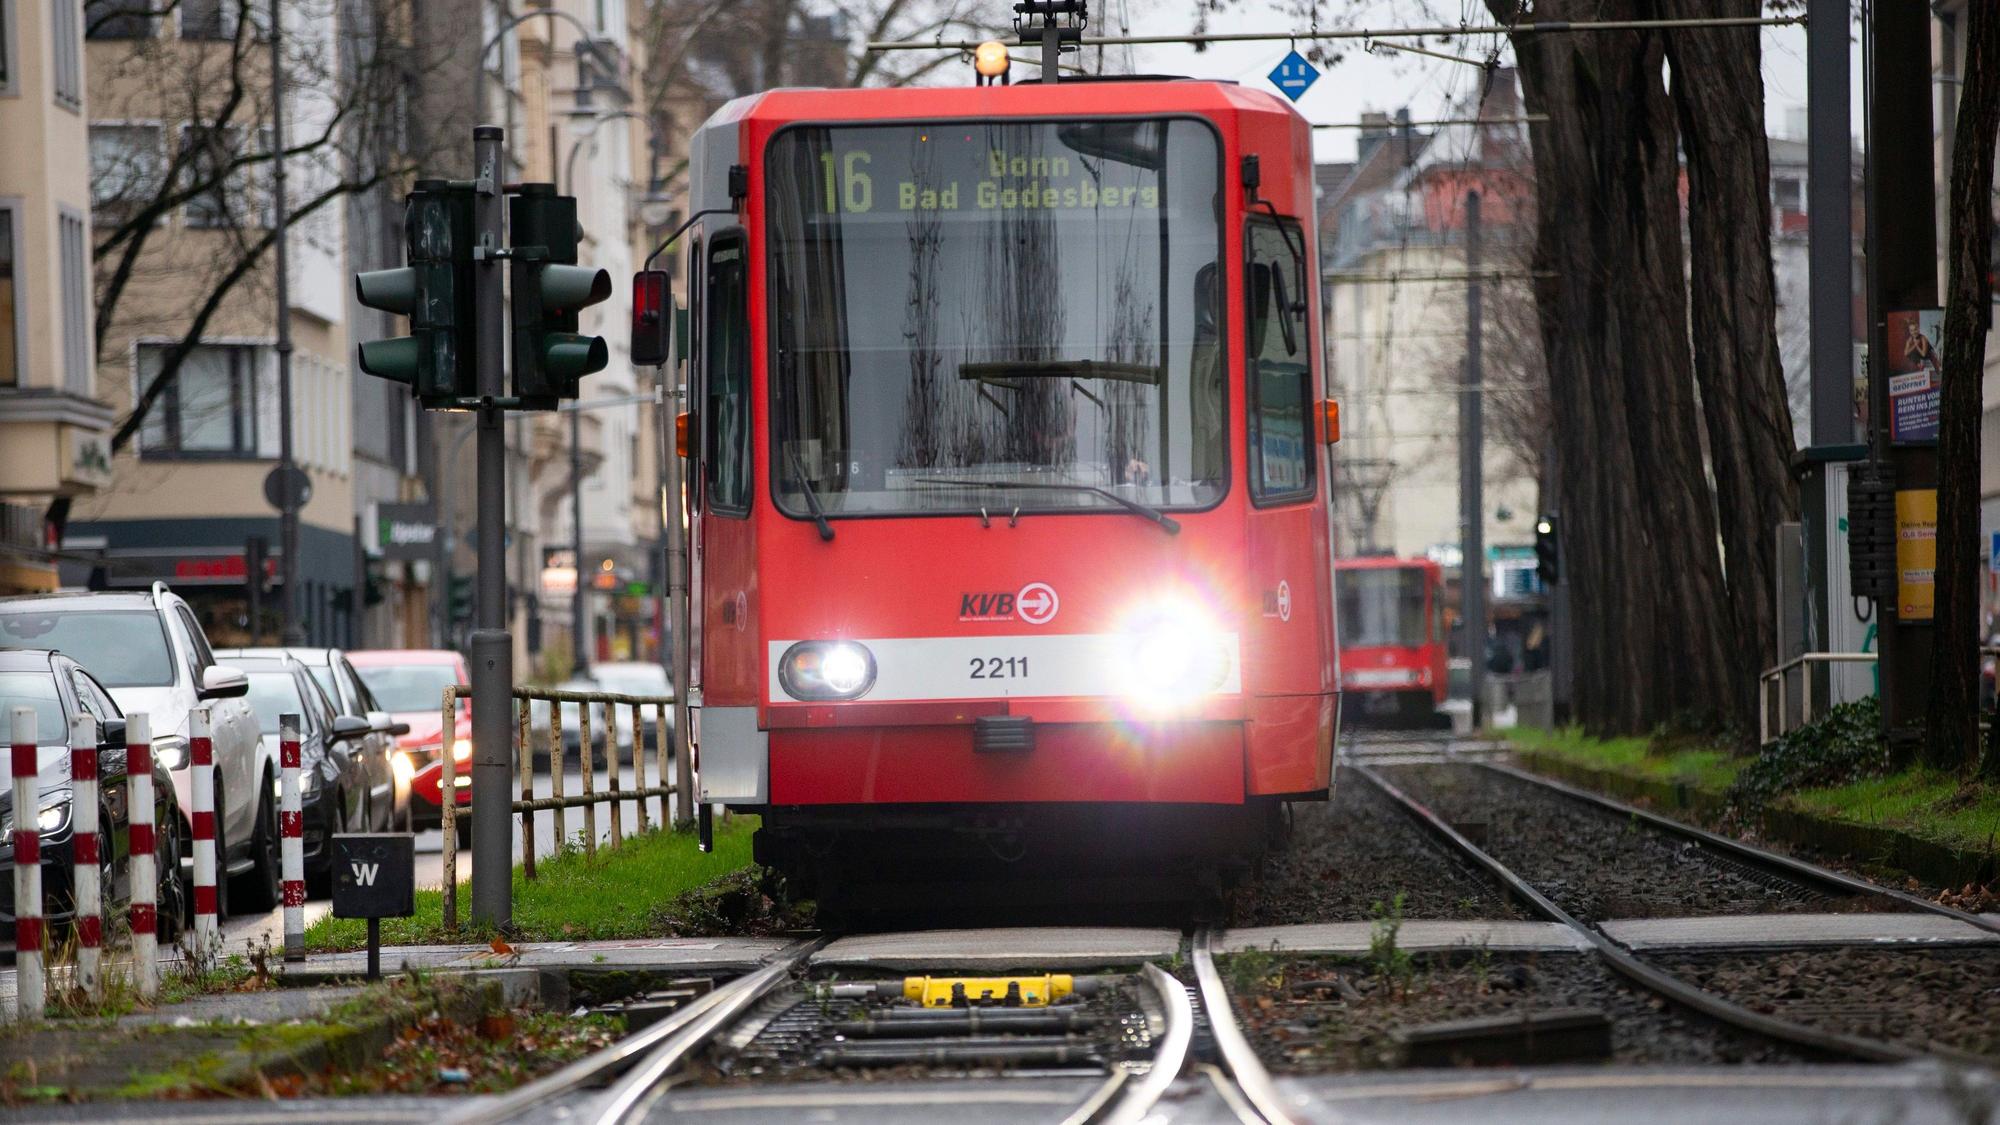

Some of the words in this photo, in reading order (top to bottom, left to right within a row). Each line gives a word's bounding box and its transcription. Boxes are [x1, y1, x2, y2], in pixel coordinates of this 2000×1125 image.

[989, 151, 1070, 178] Bonn
[820, 151, 872, 214] 16
[900, 181, 958, 210] Bad
[977, 180, 1159, 210] Godesberg
[1897, 393, 1926, 406] RUNTER
[960, 593, 1015, 616] KVB
[970, 656, 1028, 679] 2211
[351, 863, 379, 887] W
